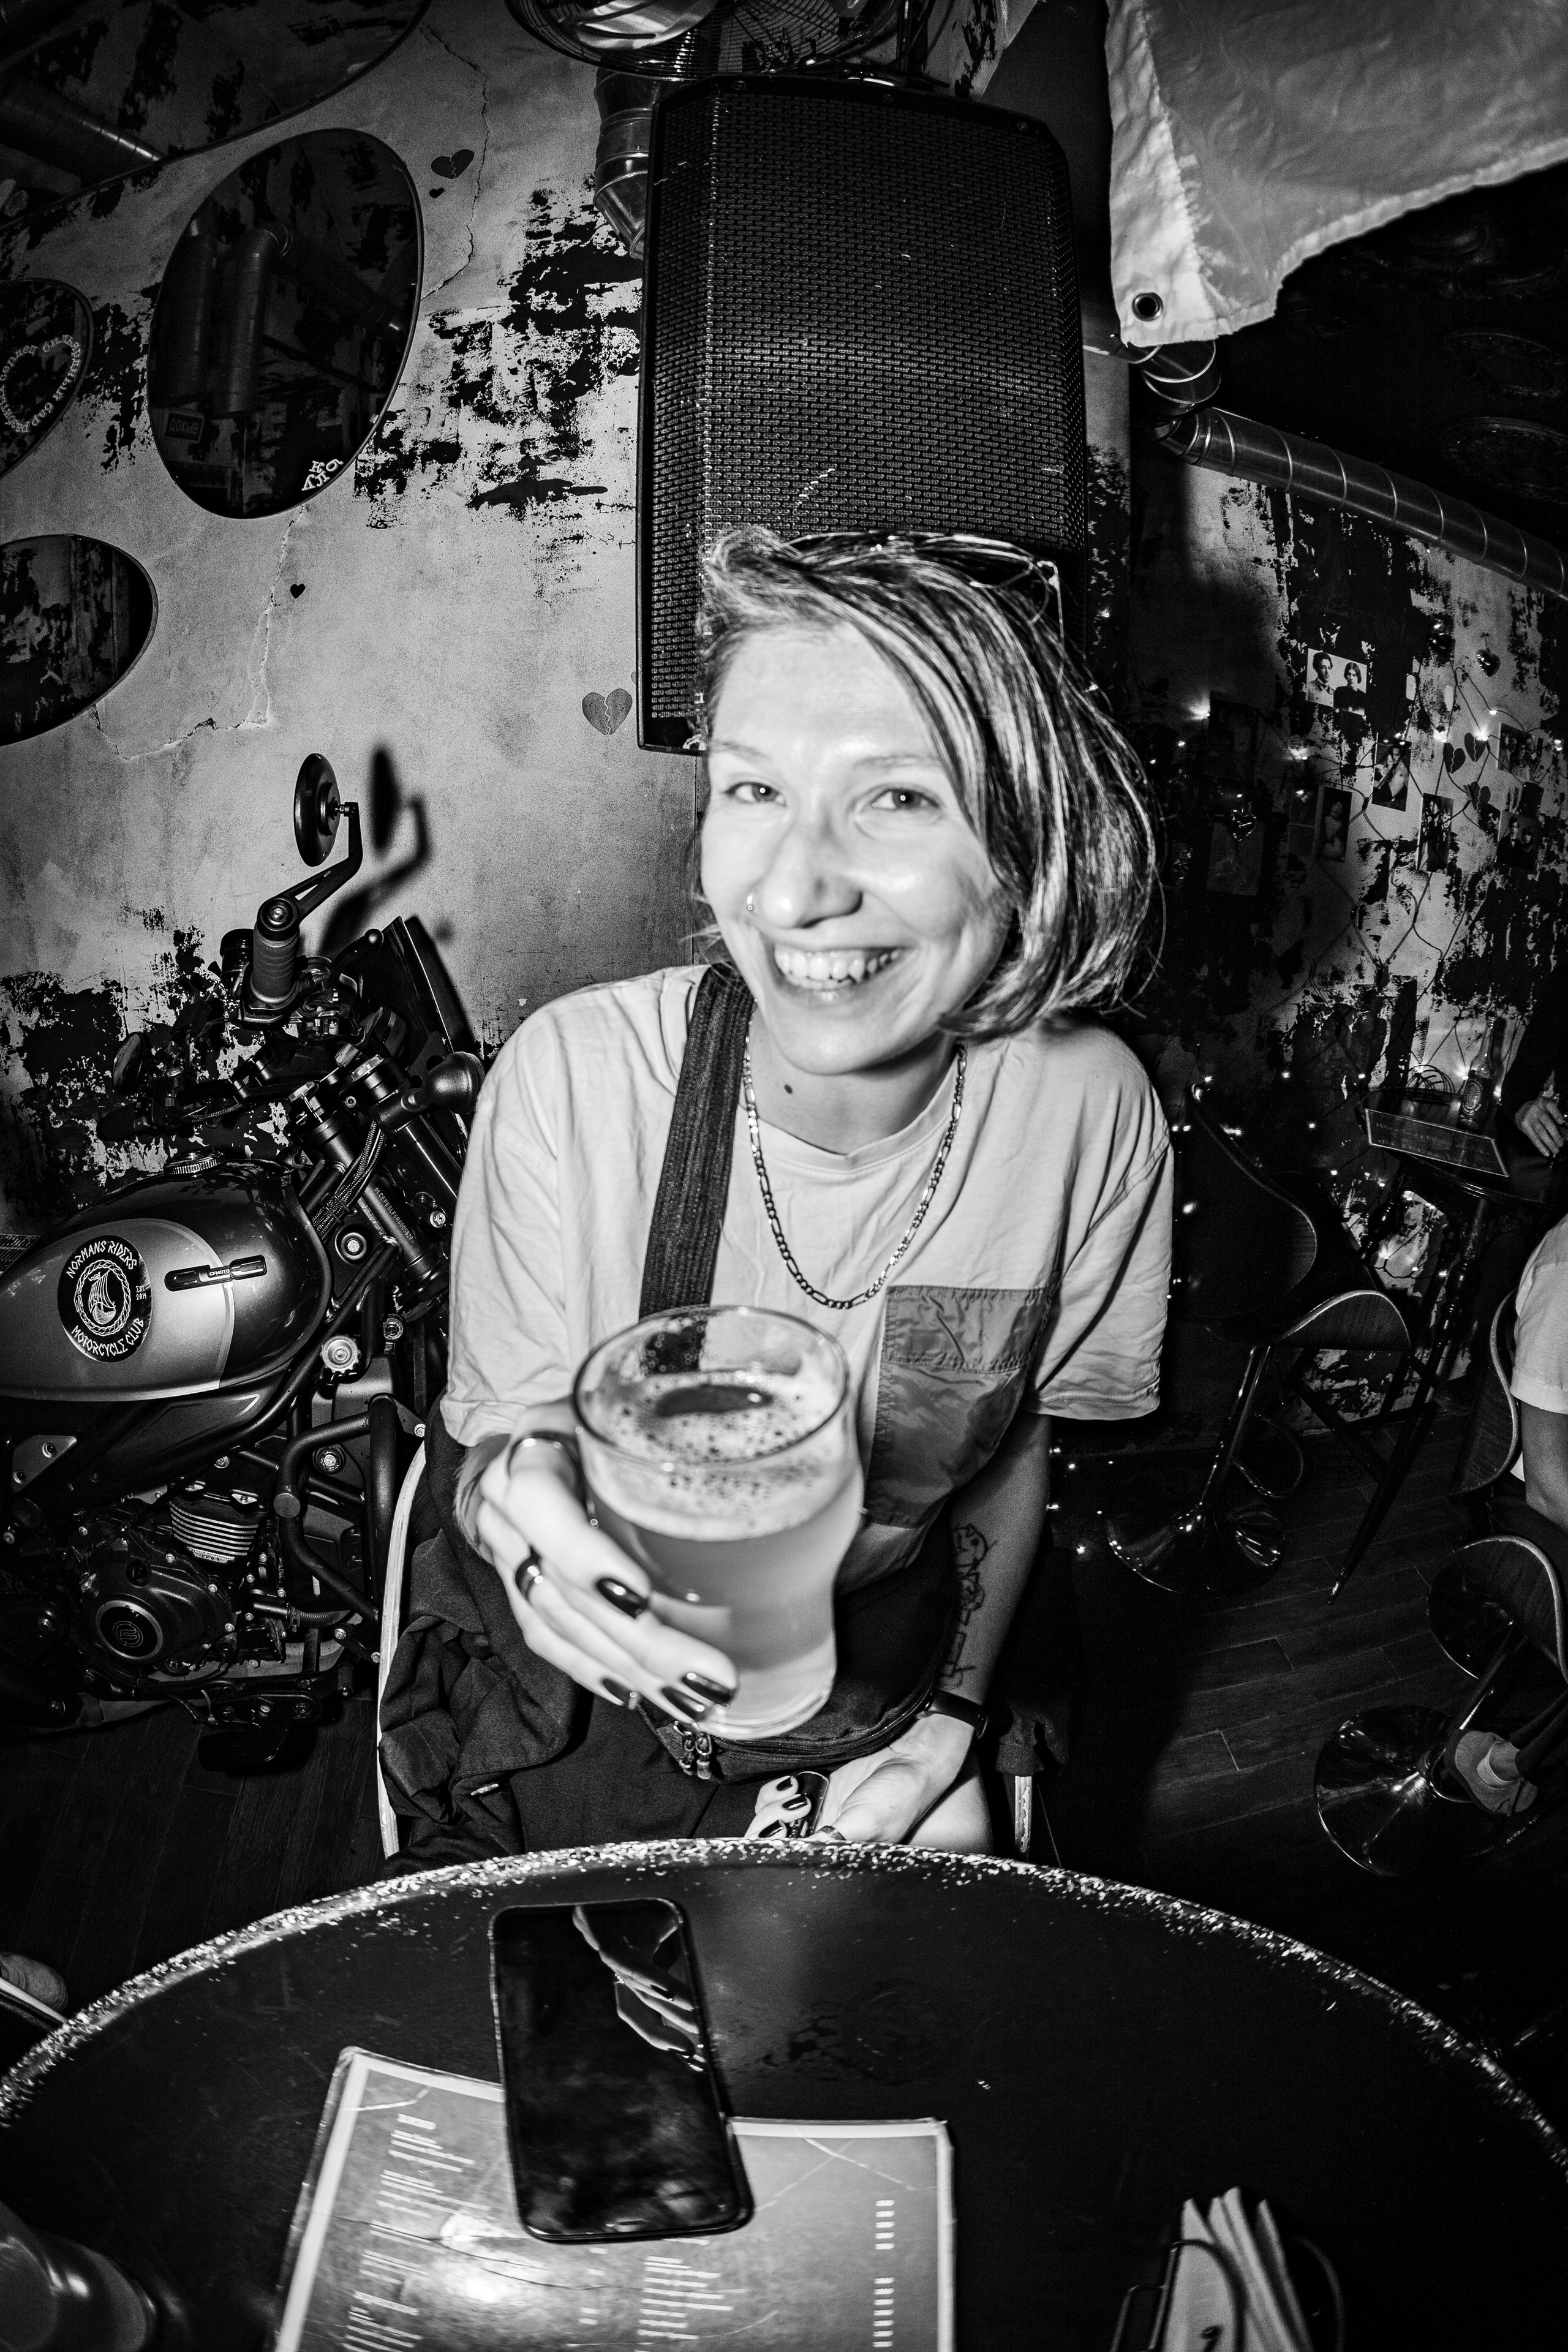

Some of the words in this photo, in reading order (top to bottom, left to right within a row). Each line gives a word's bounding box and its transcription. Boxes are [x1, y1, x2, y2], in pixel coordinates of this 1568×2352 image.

[32, 403, 53, 426] бар
[66, 1241, 107, 1278] NORMANS
[108, 1240, 138, 1270] RIDERS
[71, 1325, 129, 1357] MOTORCYCLE
[125, 1317, 145, 1346] CLUB
